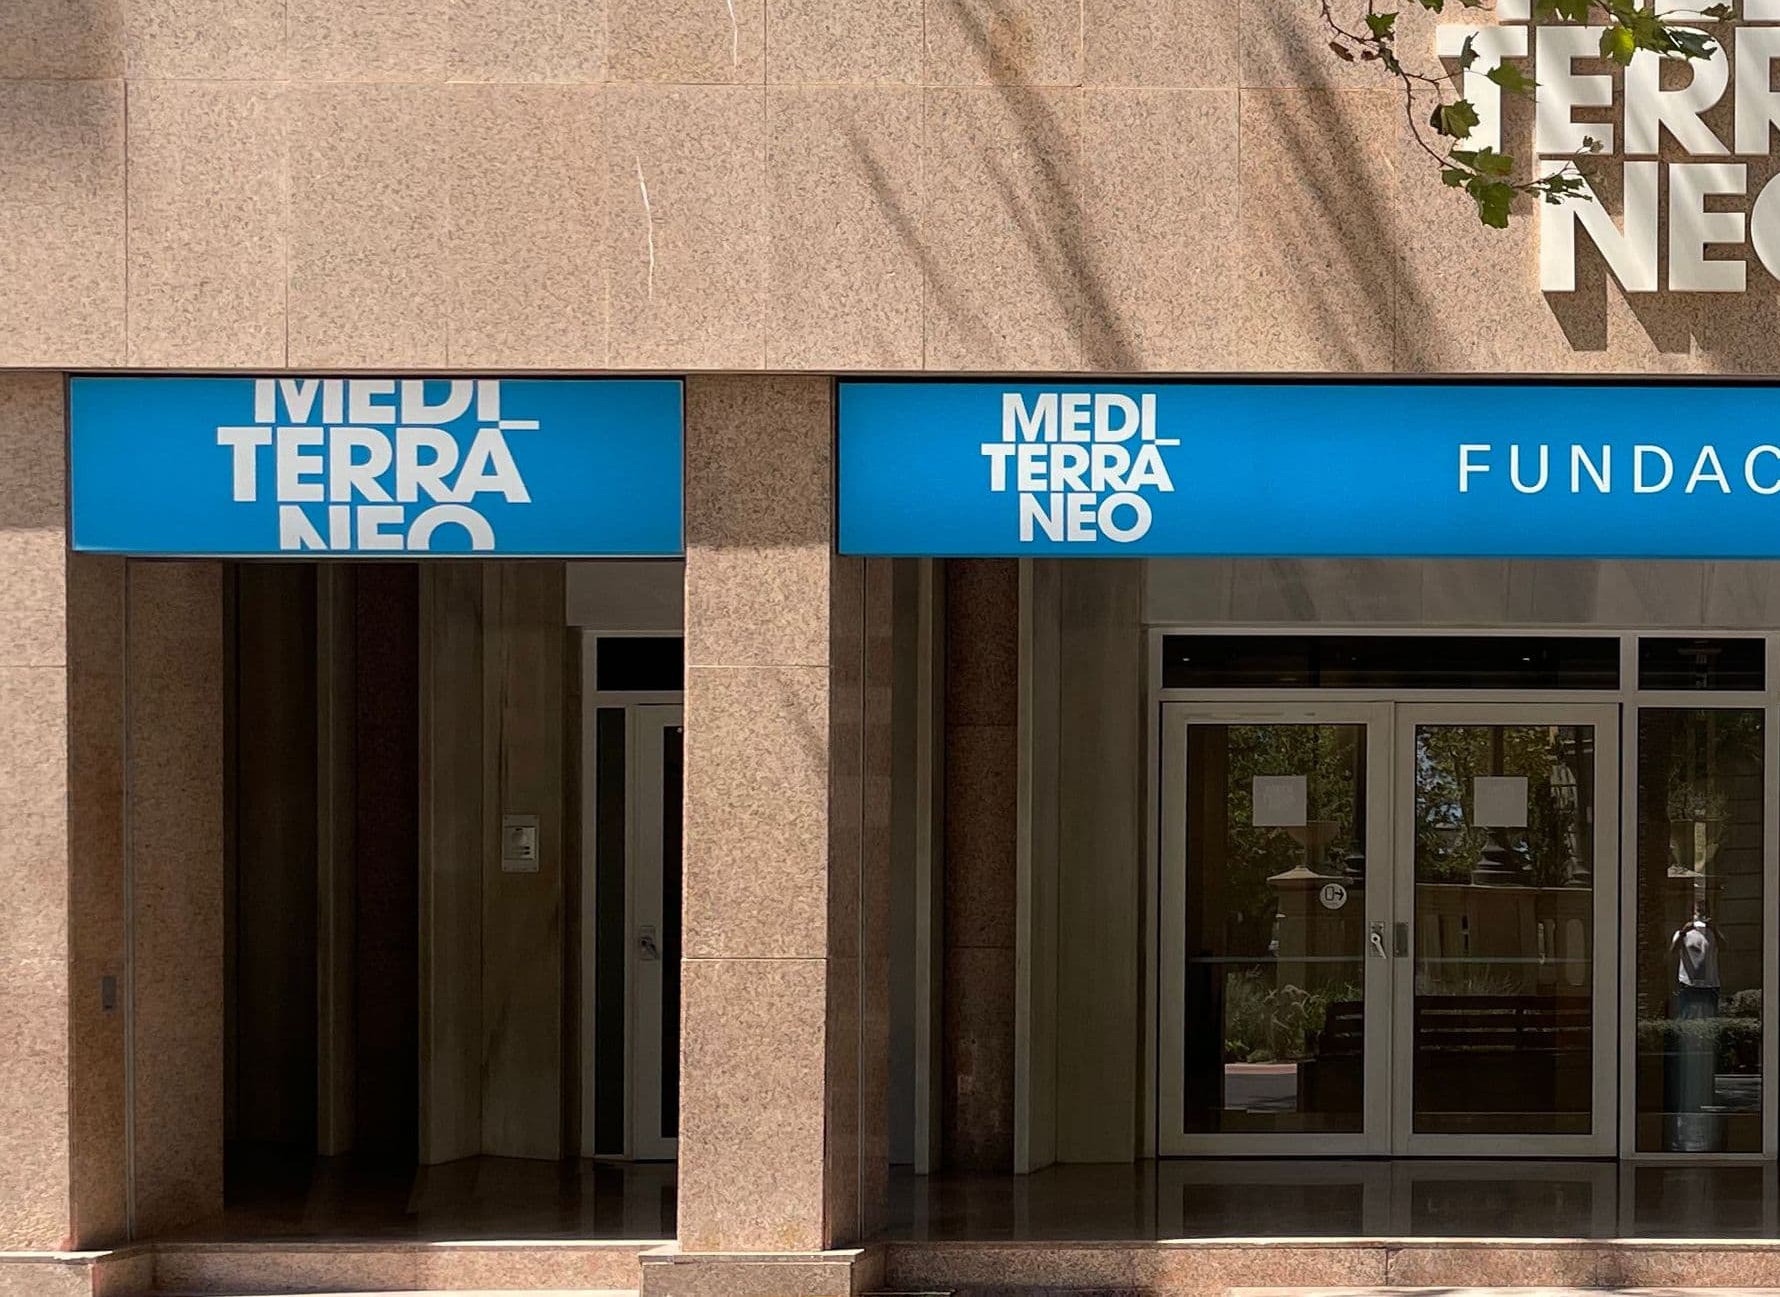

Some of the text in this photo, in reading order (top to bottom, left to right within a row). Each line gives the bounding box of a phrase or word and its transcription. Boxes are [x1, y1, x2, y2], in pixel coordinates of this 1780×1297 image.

[217, 427, 532, 503] TERRA
[981, 443, 1175, 492] TERRA
[1019, 492, 1152, 543] NEO
